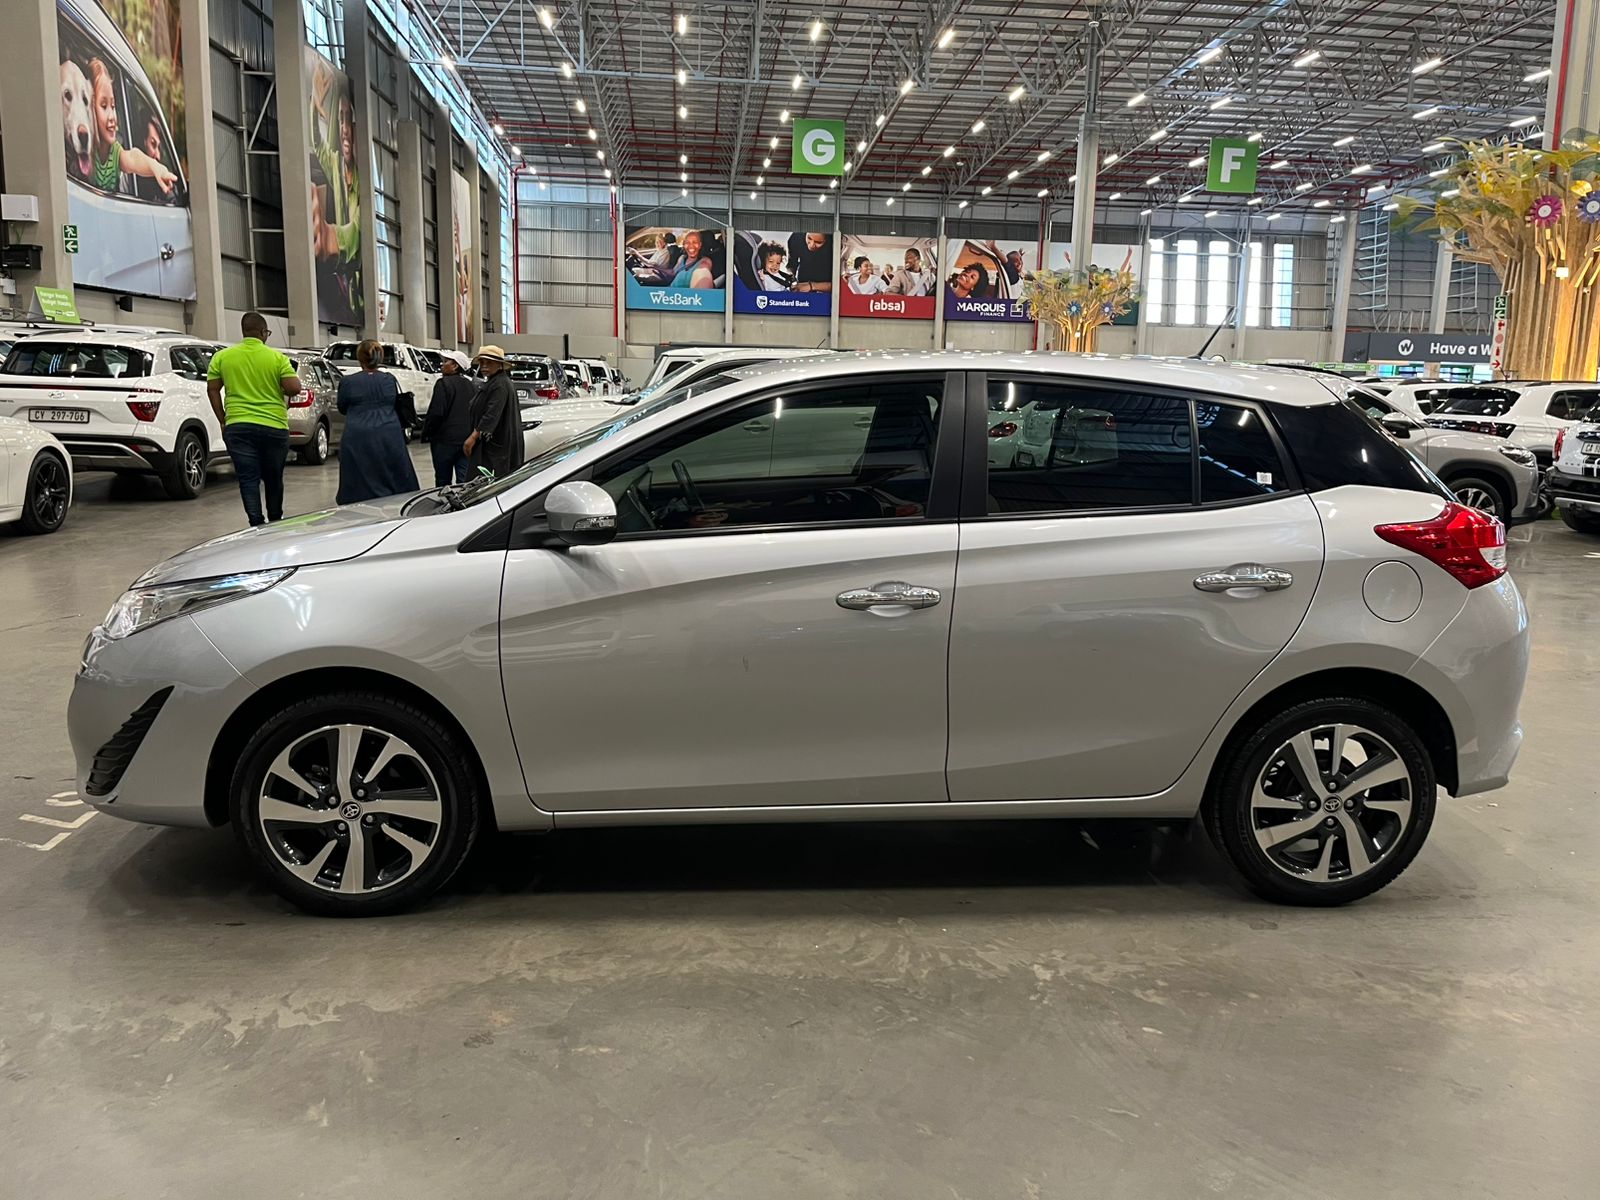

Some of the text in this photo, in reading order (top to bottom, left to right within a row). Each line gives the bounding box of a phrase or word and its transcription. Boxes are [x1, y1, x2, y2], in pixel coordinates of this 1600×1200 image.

[801, 128, 836, 166] G
[1220, 147, 1246, 183] F
[649, 290, 703, 306] WesBank
[768, 298, 810, 308] Standard Bank
[956, 302, 1006, 313] MARQUIS
[1430, 342, 1466, 355] Have
[1468, 345, 1478, 356] a
[34, 410, 85, 421] CY 297-706
